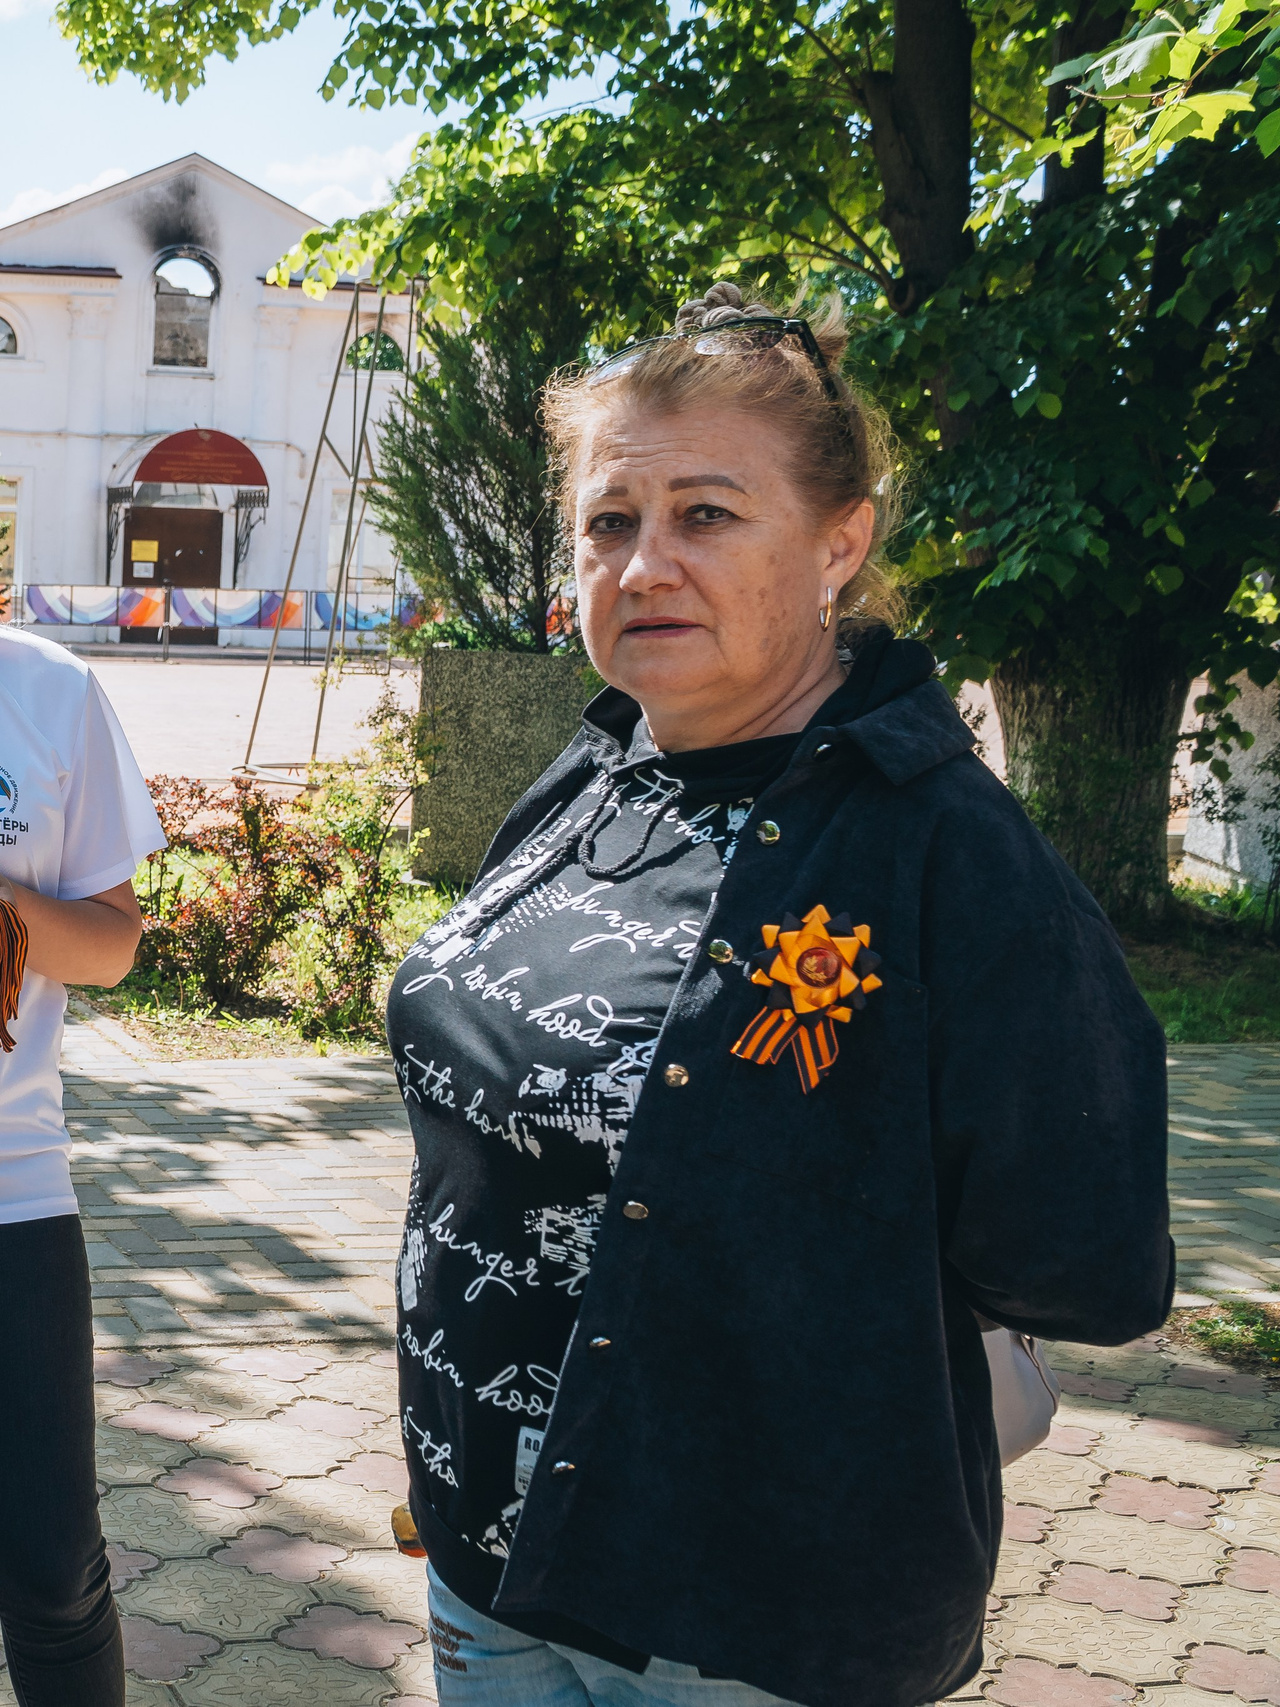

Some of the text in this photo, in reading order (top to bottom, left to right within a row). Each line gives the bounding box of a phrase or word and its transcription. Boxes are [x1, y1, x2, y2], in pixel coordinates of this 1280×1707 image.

[9, 779, 19, 815] ДВИЖЕНИЕ
[568, 882, 678, 953] hunger
[461, 964, 531, 1011] robin
[525, 993, 645, 1048] hood
[404, 1044, 456, 1108] the
[428, 1203, 540, 1302] hunger
[402, 1324, 464, 1387] robin
[524, 1436, 540, 1453] RO
